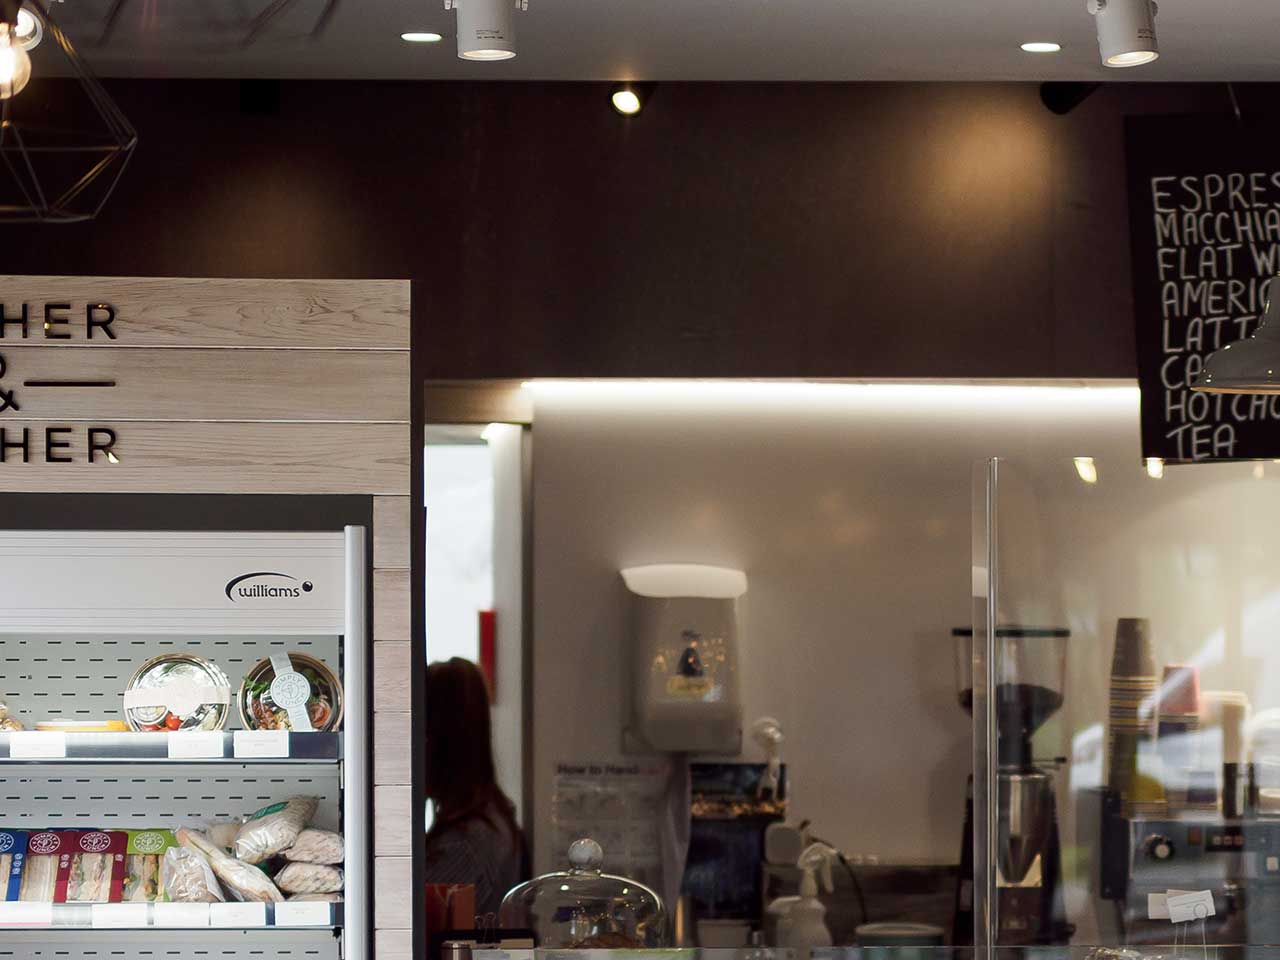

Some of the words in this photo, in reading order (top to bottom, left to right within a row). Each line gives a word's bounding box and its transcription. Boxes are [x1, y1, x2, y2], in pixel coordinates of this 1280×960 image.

[1157, 243, 1243, 281] FLAT
[0, 303, 117, 340] HER
[0, 427, 119, 464] HER
[1165, 424, 1237, 461] TEA
[237, 584, 300, 599] williams
